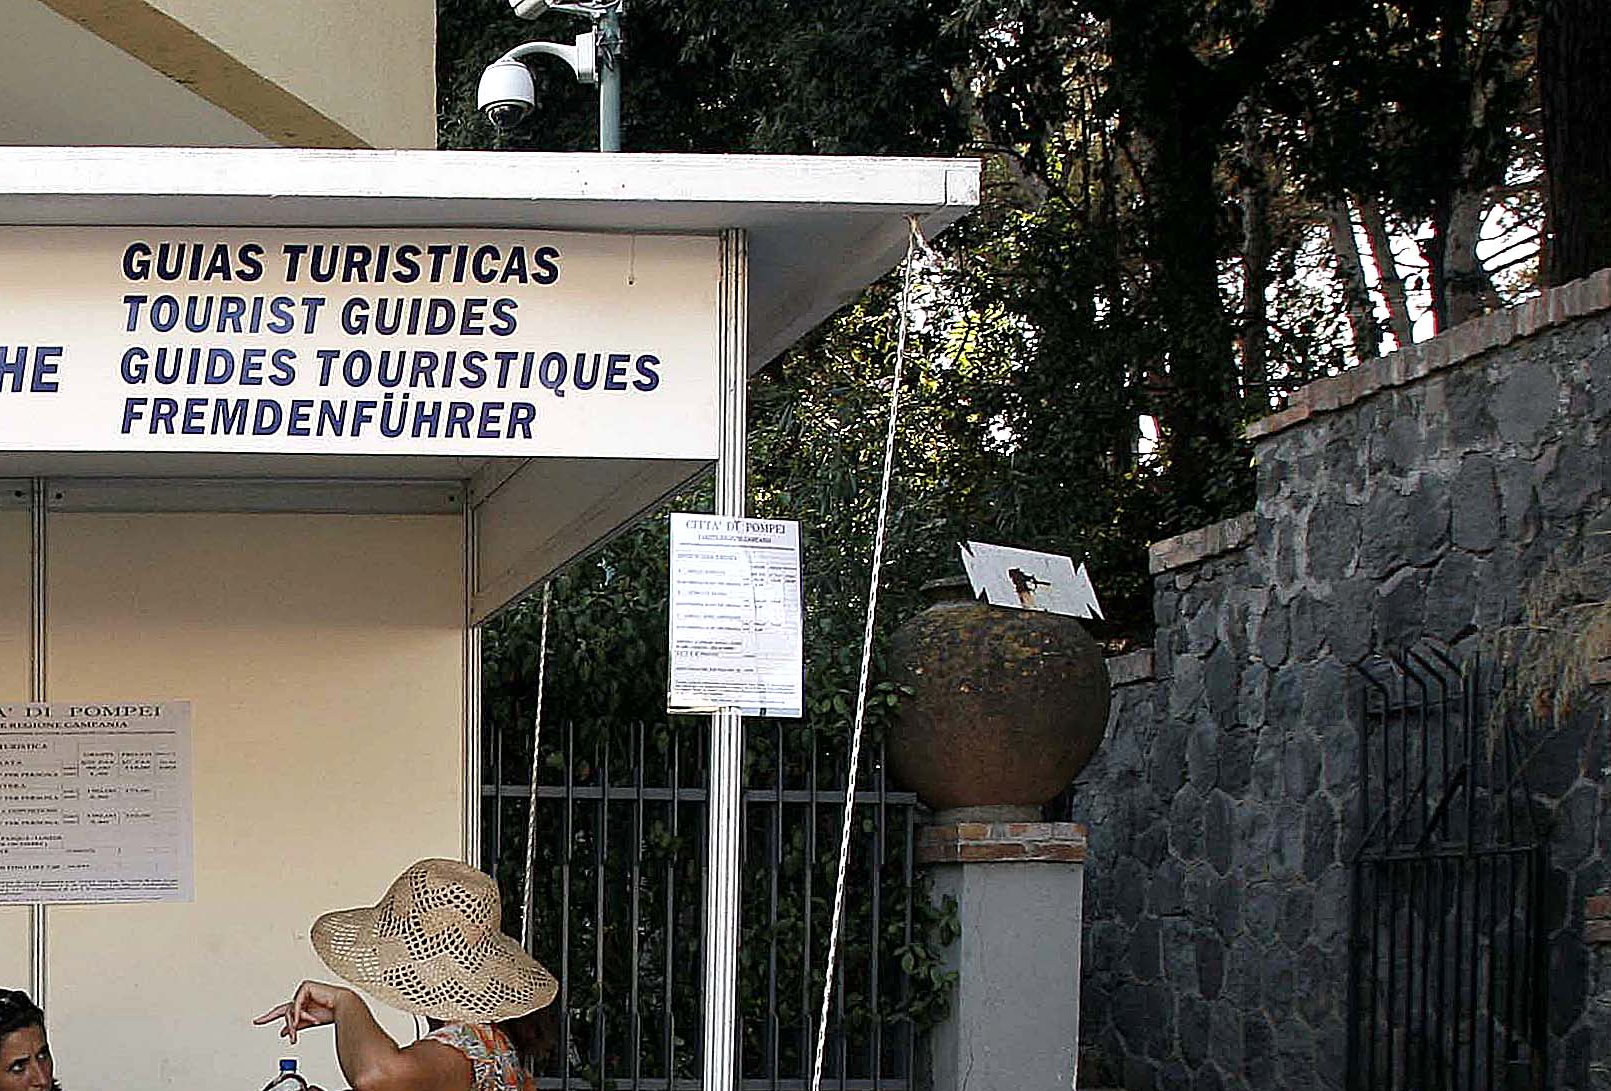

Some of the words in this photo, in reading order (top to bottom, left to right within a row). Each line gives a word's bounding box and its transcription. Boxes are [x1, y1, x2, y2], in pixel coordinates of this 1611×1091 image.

[122, 242, 266, 282] GUIAS
[282, 244, 561, 284] TURISTICAS
[122, 294, 327, 335] TOURIST
[341, 297, 519, 337] GUIDES
[120, 346, 298, 386] GUIDES
[315, 349, 662, 397] TOURISTIQUES
[120, 392, 538, 439] FREMDENFÜHRER
[745, 521, 787, 535] POMPEI
[25, 705, 51, 718] DI
[70, 705, 161, 718] POMPEI
[63, 720, 129, 729] CAMPANIA
